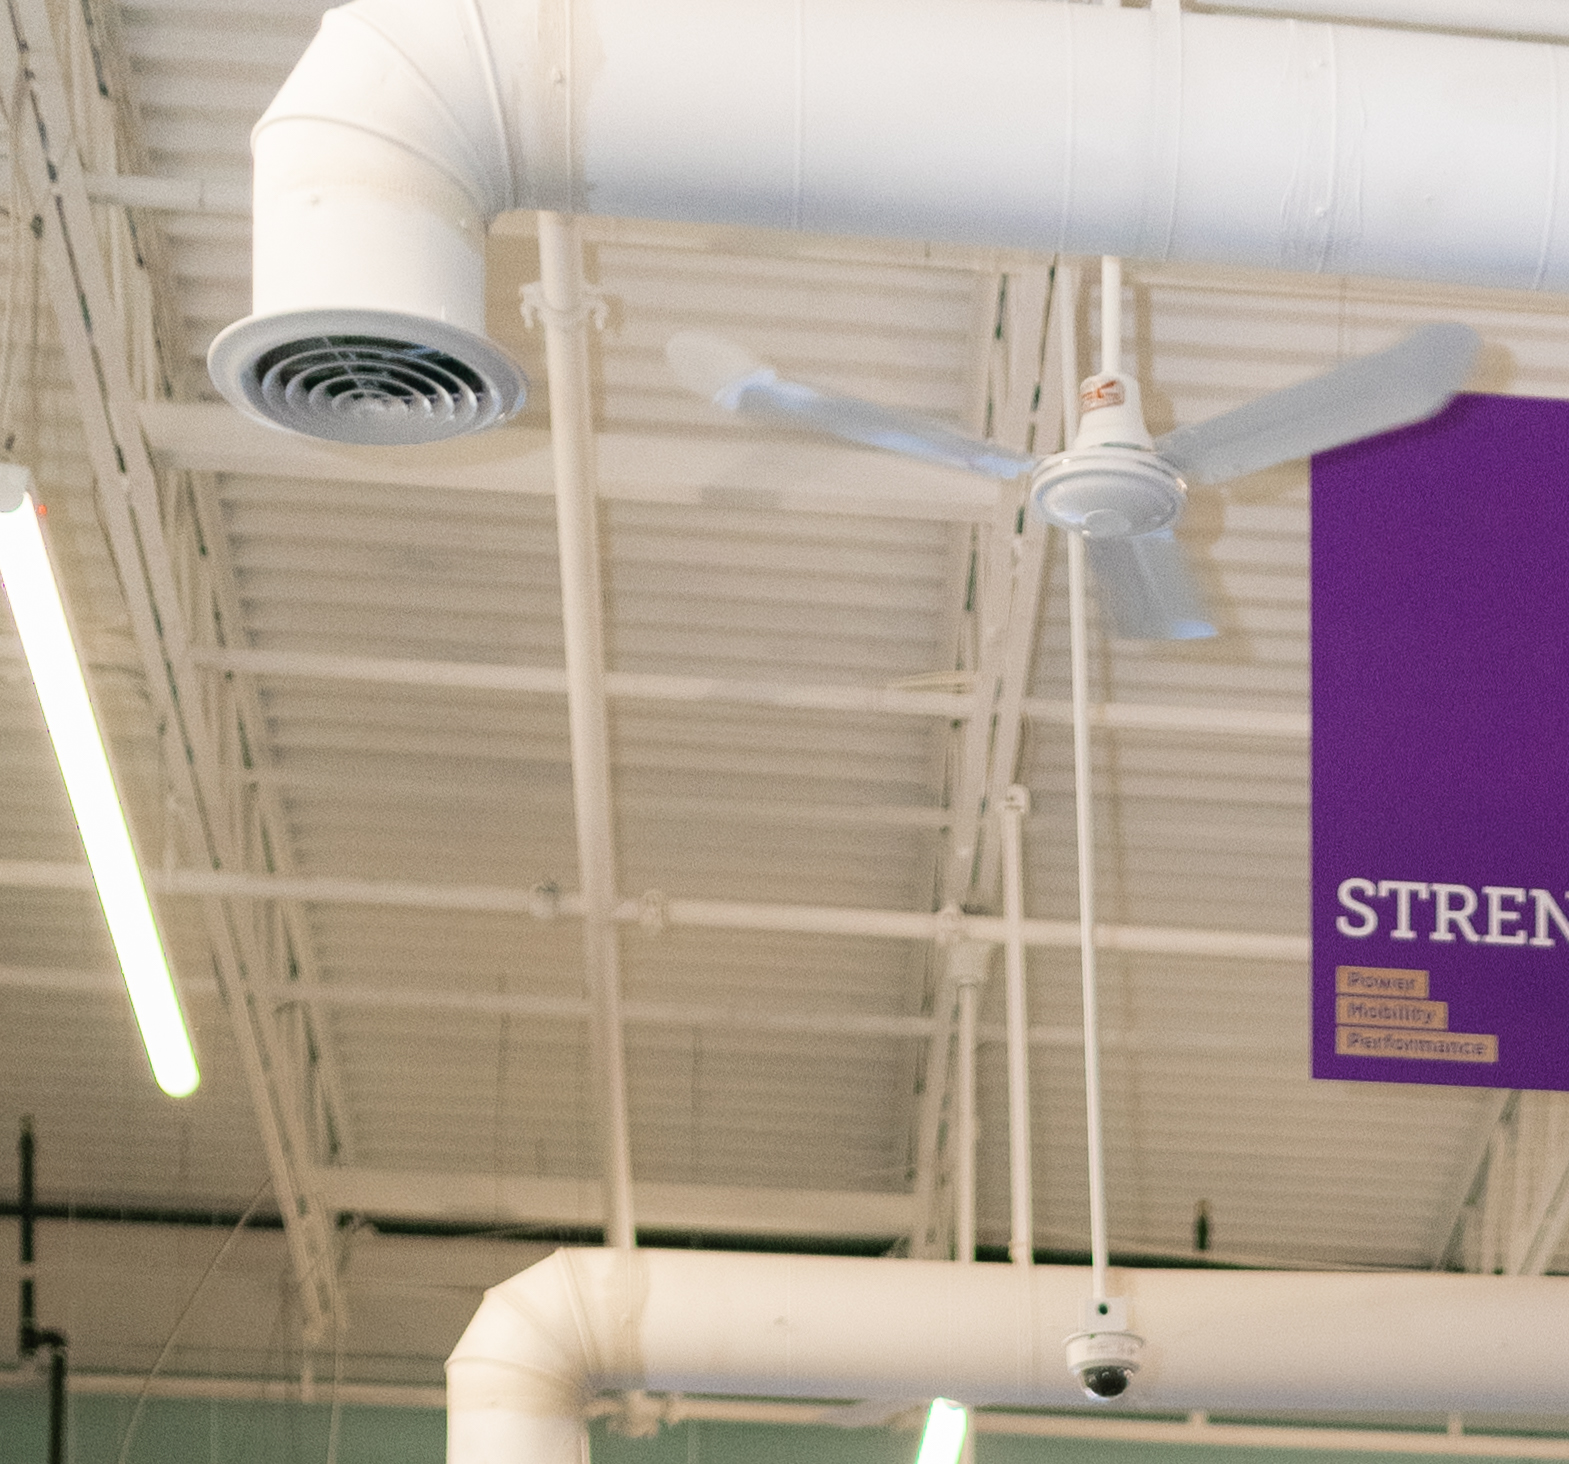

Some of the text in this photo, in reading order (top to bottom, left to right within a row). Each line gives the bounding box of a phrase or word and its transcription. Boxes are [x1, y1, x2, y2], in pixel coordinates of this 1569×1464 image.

[1347, 972, 1416, 991] Power
[1347, 1002, 1435, 1025] Mobility
[1346, 1032, 1488, 1056] Performance
